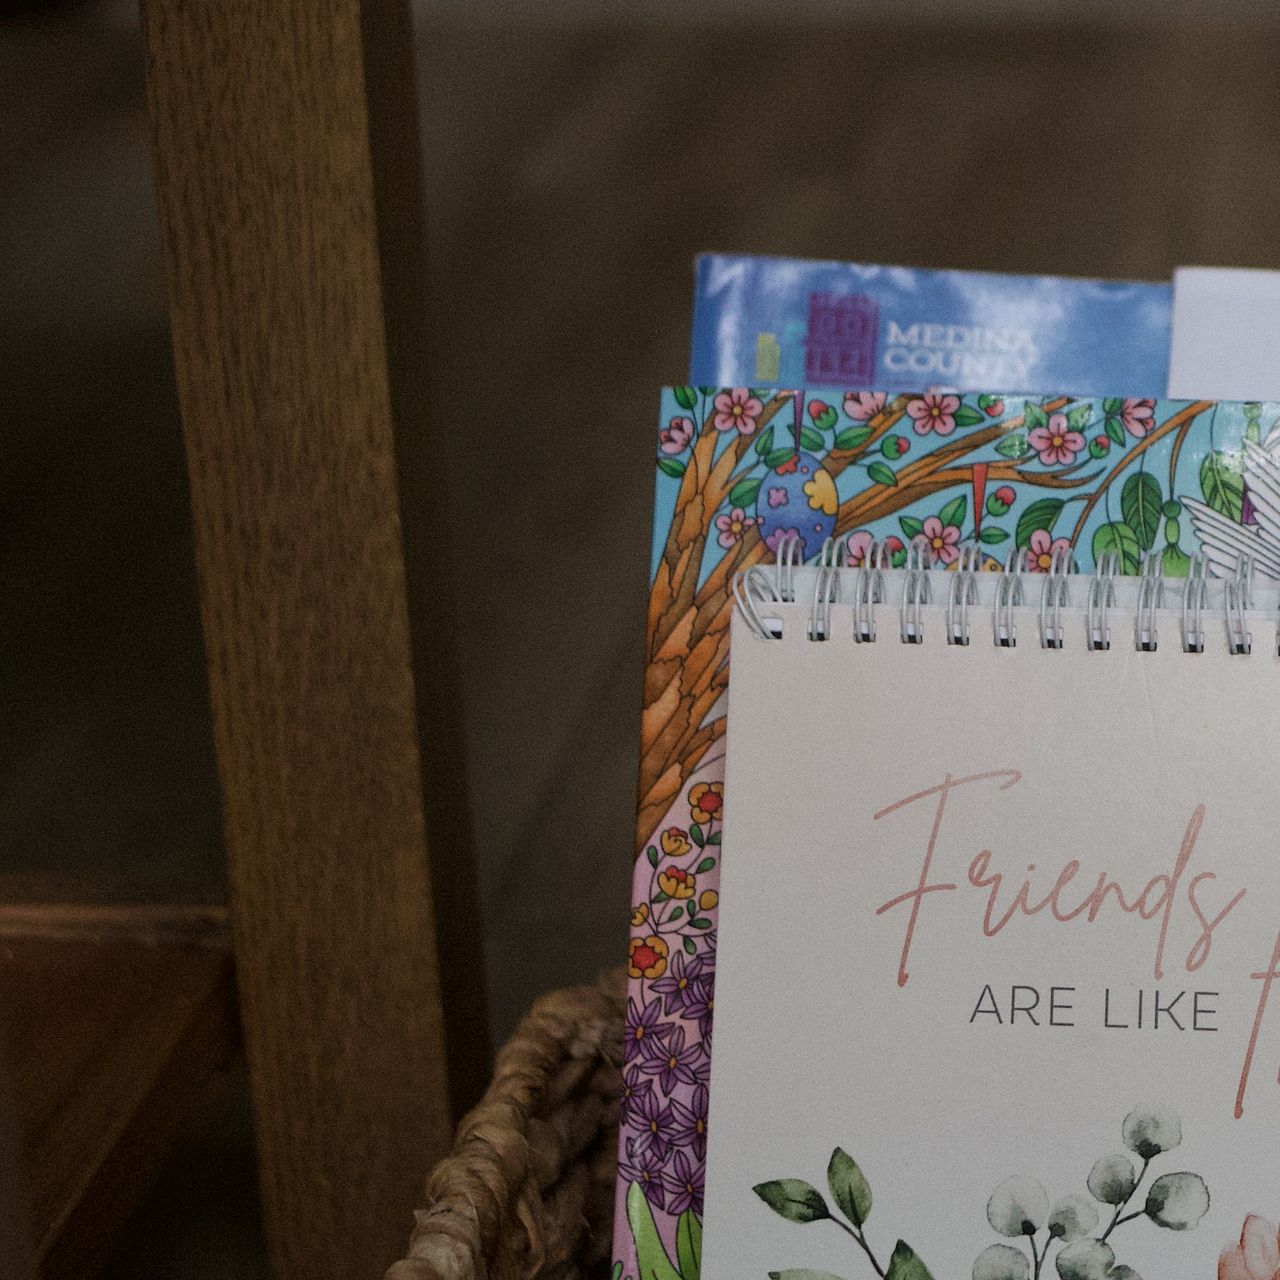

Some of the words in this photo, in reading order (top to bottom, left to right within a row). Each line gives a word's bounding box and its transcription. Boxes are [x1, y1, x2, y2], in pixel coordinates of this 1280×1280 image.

[873, 768, 1248, 987] Friends
[969, 984, 1077, 1028] ARE
[1103, 988, 1221, 1033] LIKE
